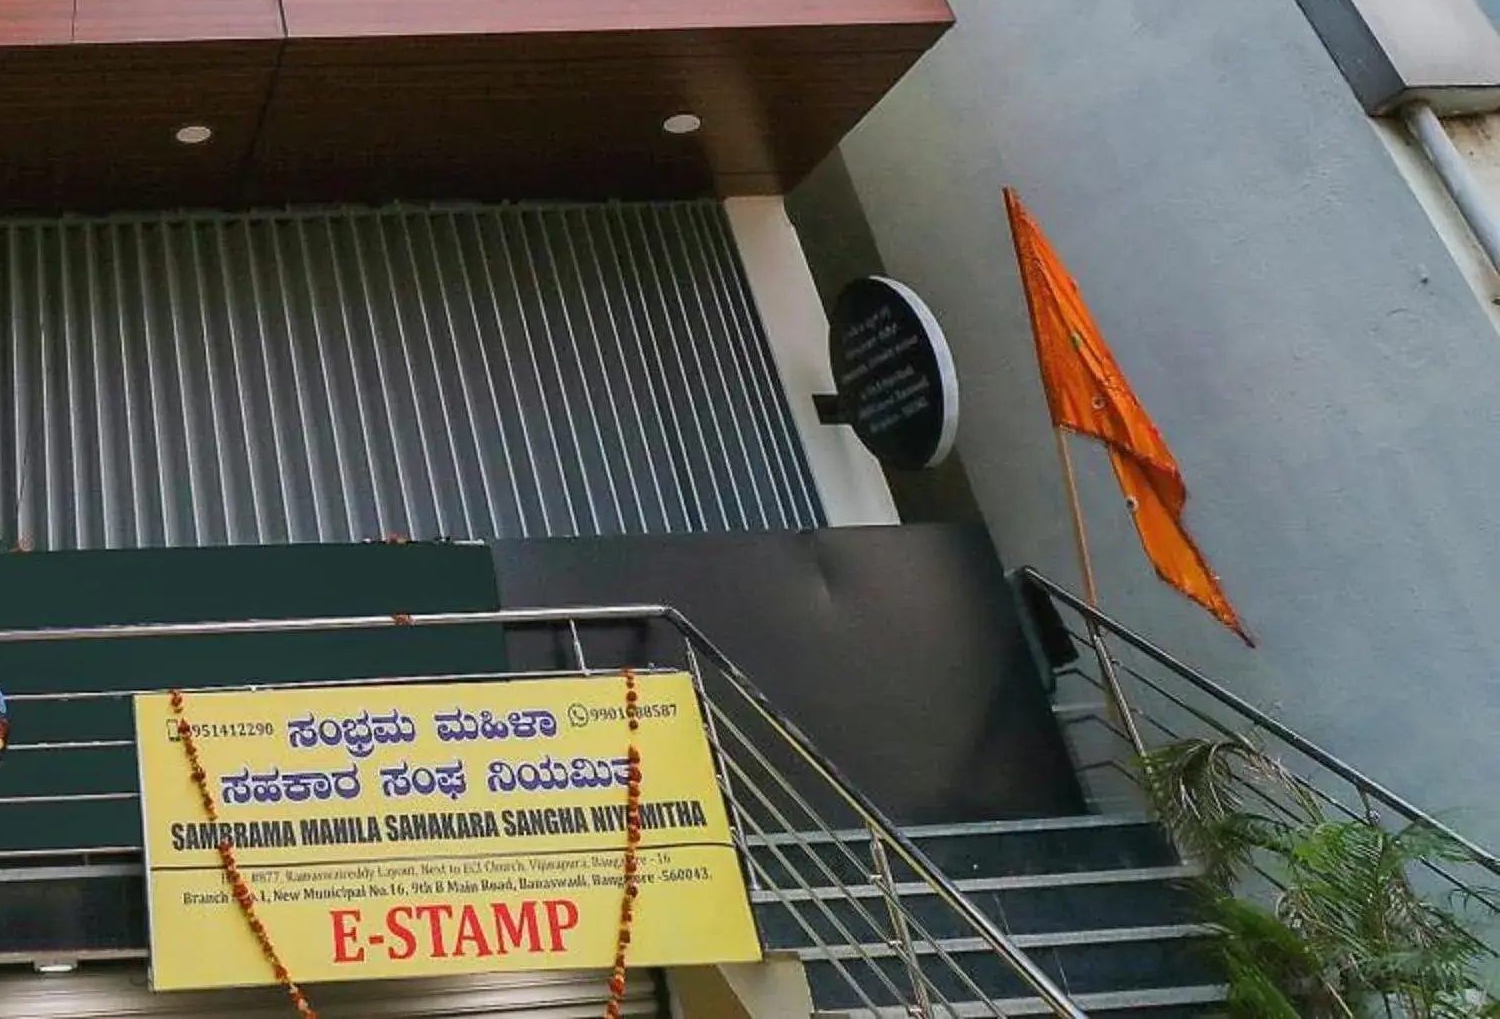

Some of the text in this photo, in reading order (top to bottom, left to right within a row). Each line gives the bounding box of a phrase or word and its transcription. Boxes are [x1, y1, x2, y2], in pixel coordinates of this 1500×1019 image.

[184, 722, 274, 738] 951412290
[435, 706, 558, 741] ಮಹಿಳಾ
[221, 763, 361, 804] ಸಹಕಾರ
[172, 800, 708, 851] SAMBRAMA MAHILA SAHAKARA SANGHA NIYMITHA
[183, 891, 229, 905] Branch
[274, 889, 300, 902] New
[303, 883, 367, 902] Municipal
[447, 880, 479, 894] Main
[330, 899, 580, 963] E-STAMP
